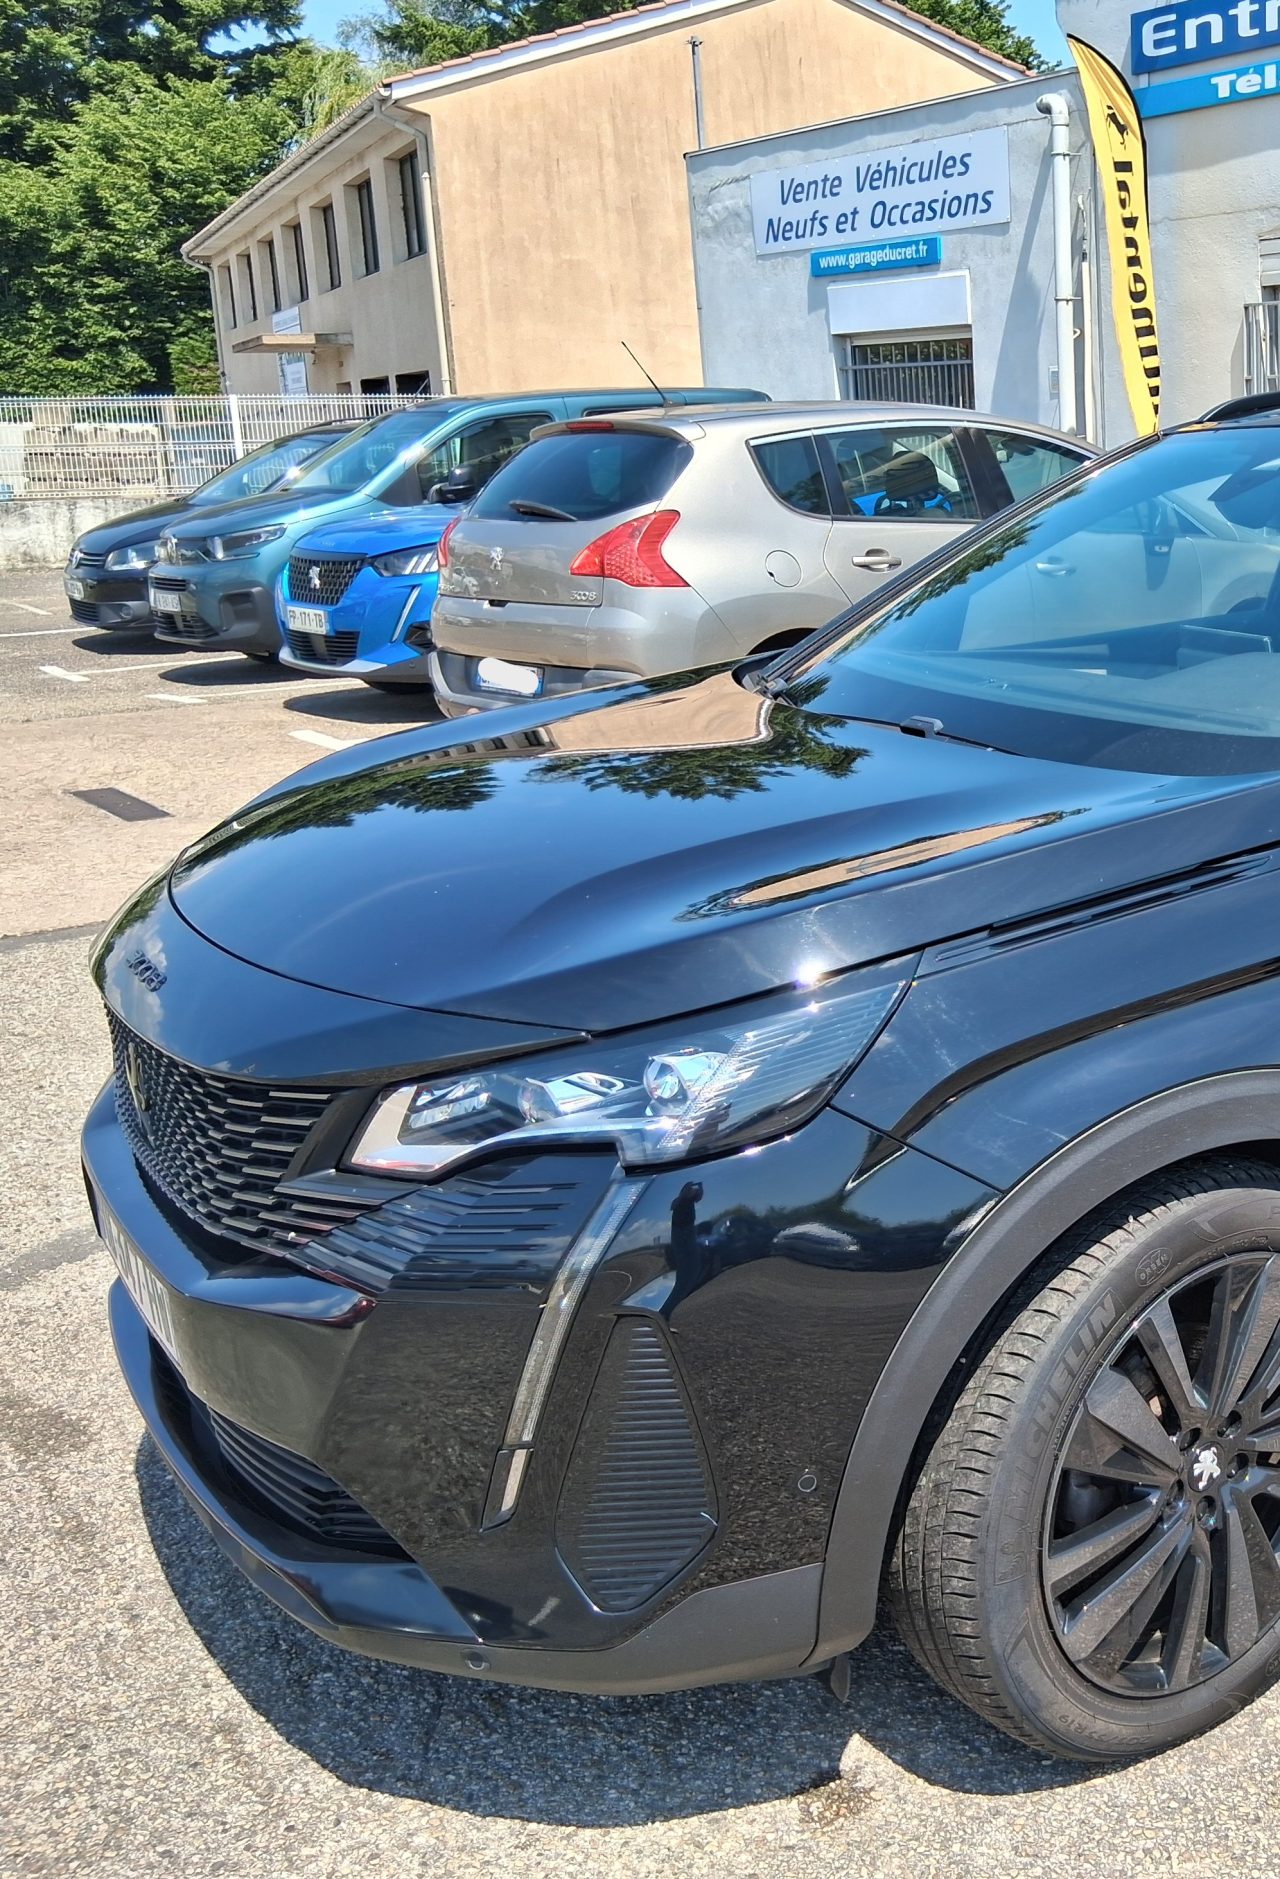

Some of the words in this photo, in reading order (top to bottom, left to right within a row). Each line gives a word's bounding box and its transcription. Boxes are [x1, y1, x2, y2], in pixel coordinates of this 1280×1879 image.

[779, 173, 842, 206] Vente
[855, 149, 972, 193] Véhicules
[765, 208, 828, 244] Neufs
[835, 207, 857, 234] et
[869, 188, 994, 229] Occasions
[819, 243, 928, 271] www.garageducret.fr
[570, 590, 597, 601] 3008
[1004, 1291, 1118, 1523] MICHELIN
